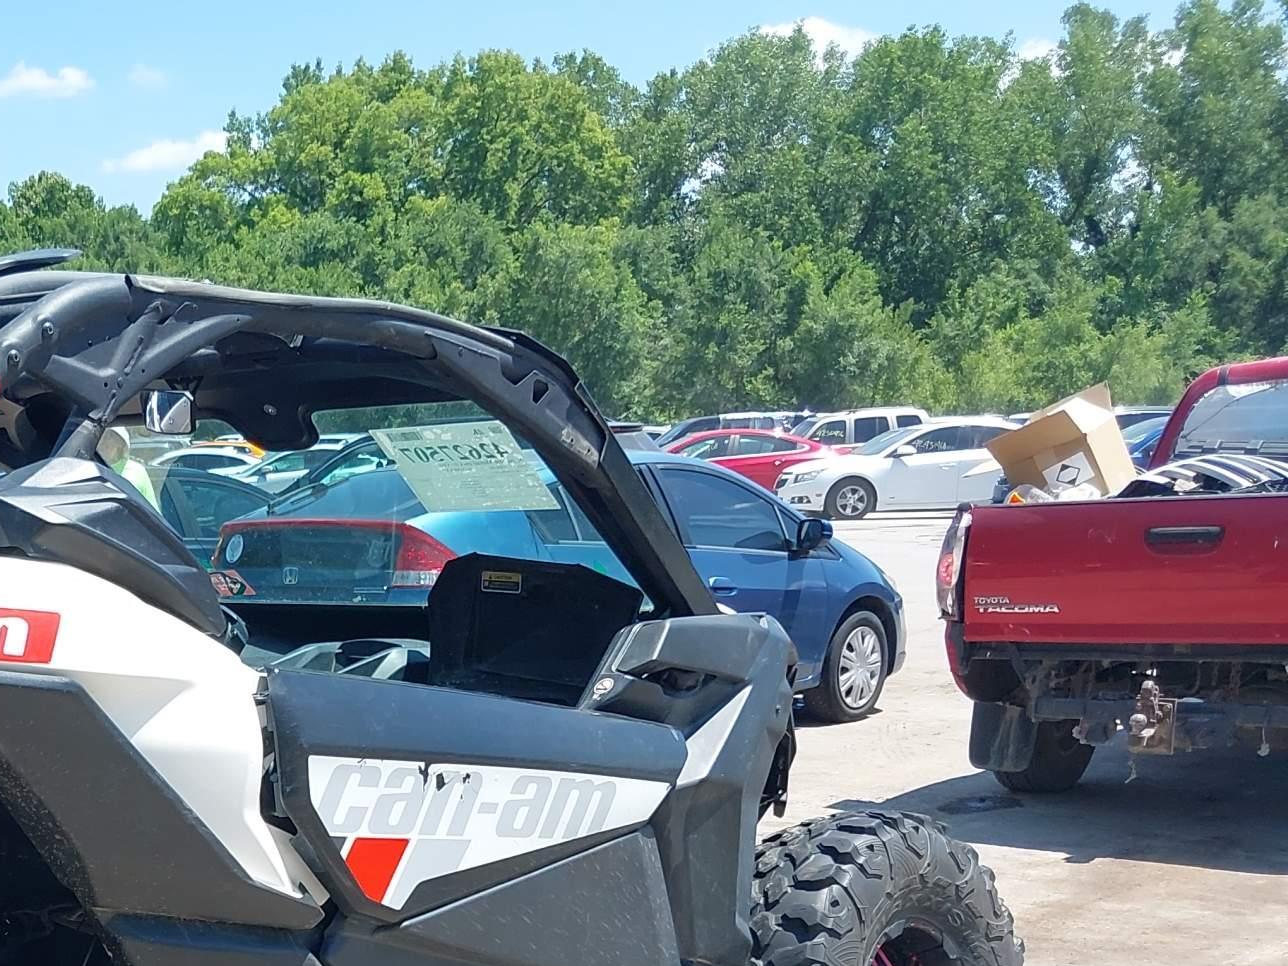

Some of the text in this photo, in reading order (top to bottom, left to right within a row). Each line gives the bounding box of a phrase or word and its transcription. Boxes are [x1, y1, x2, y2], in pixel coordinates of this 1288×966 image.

[973, 596, 1010, 604] TOYOTA
[974, 604, 1060, 613] TACOMA
[322, 763, 618, 839] can-am
